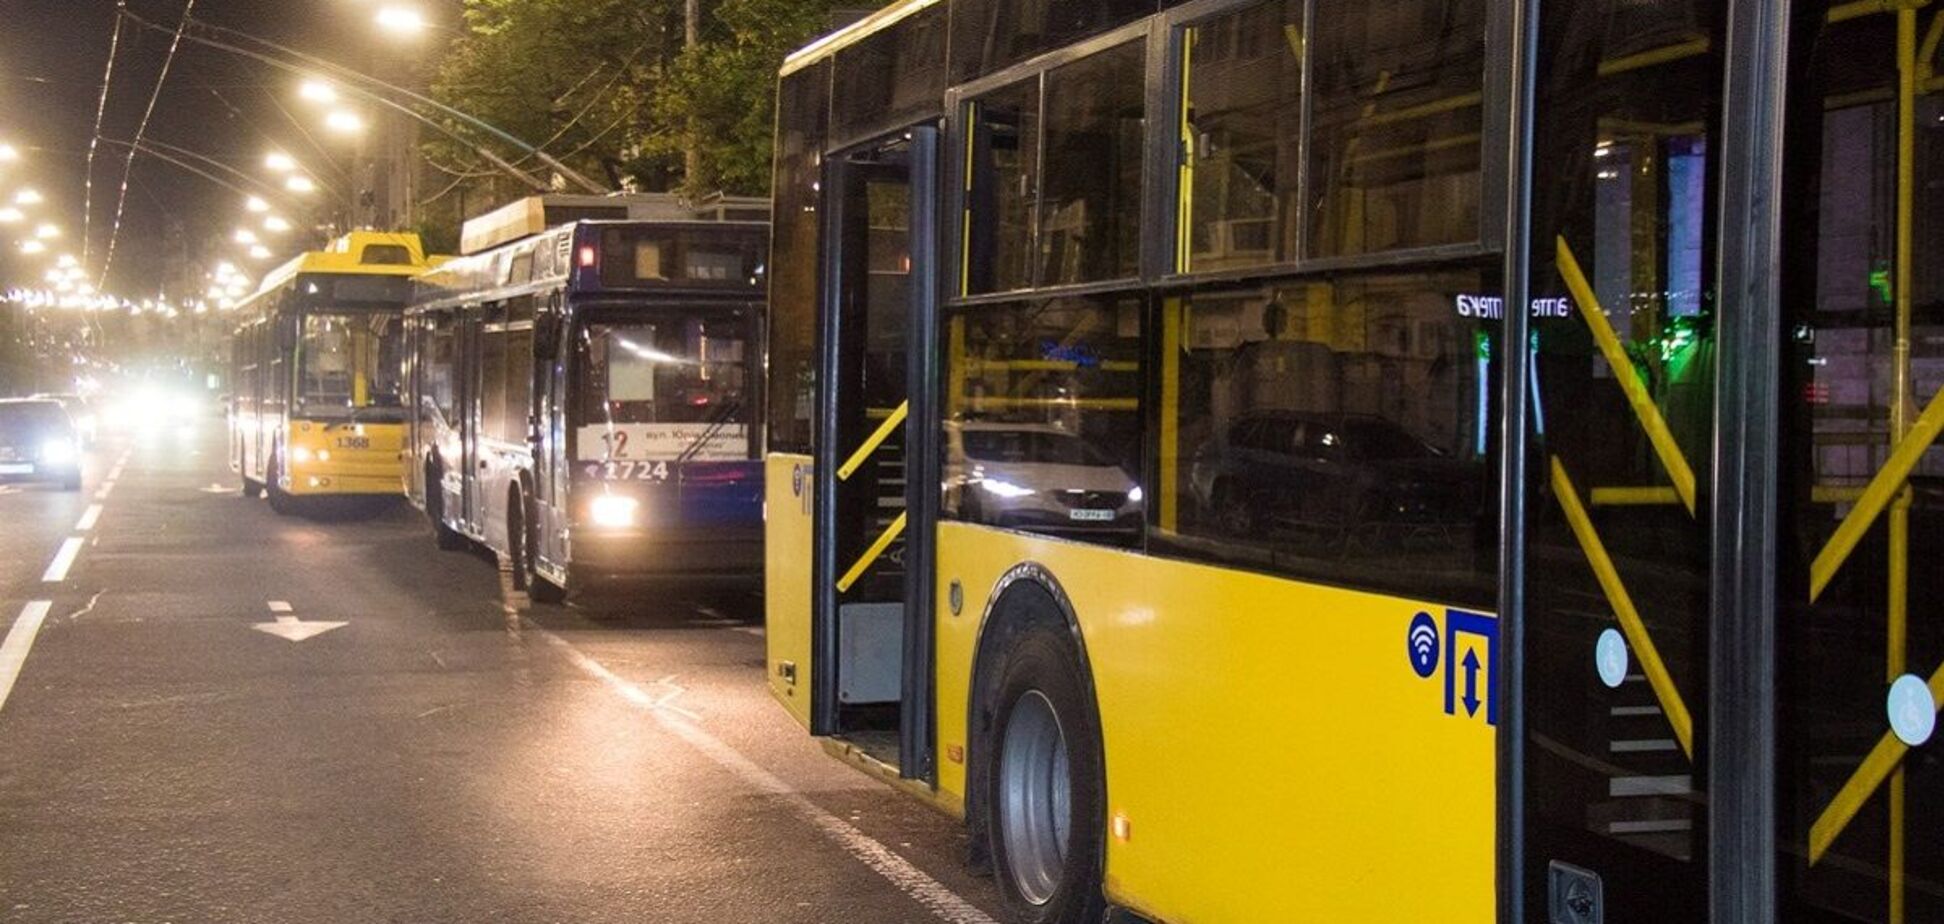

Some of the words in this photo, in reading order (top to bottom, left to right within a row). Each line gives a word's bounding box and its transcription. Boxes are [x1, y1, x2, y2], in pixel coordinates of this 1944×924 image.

[337, 436, 369, 449] 1368
[602, 430, 628, 458] 12
[604, 461, 669, 480] 1724
